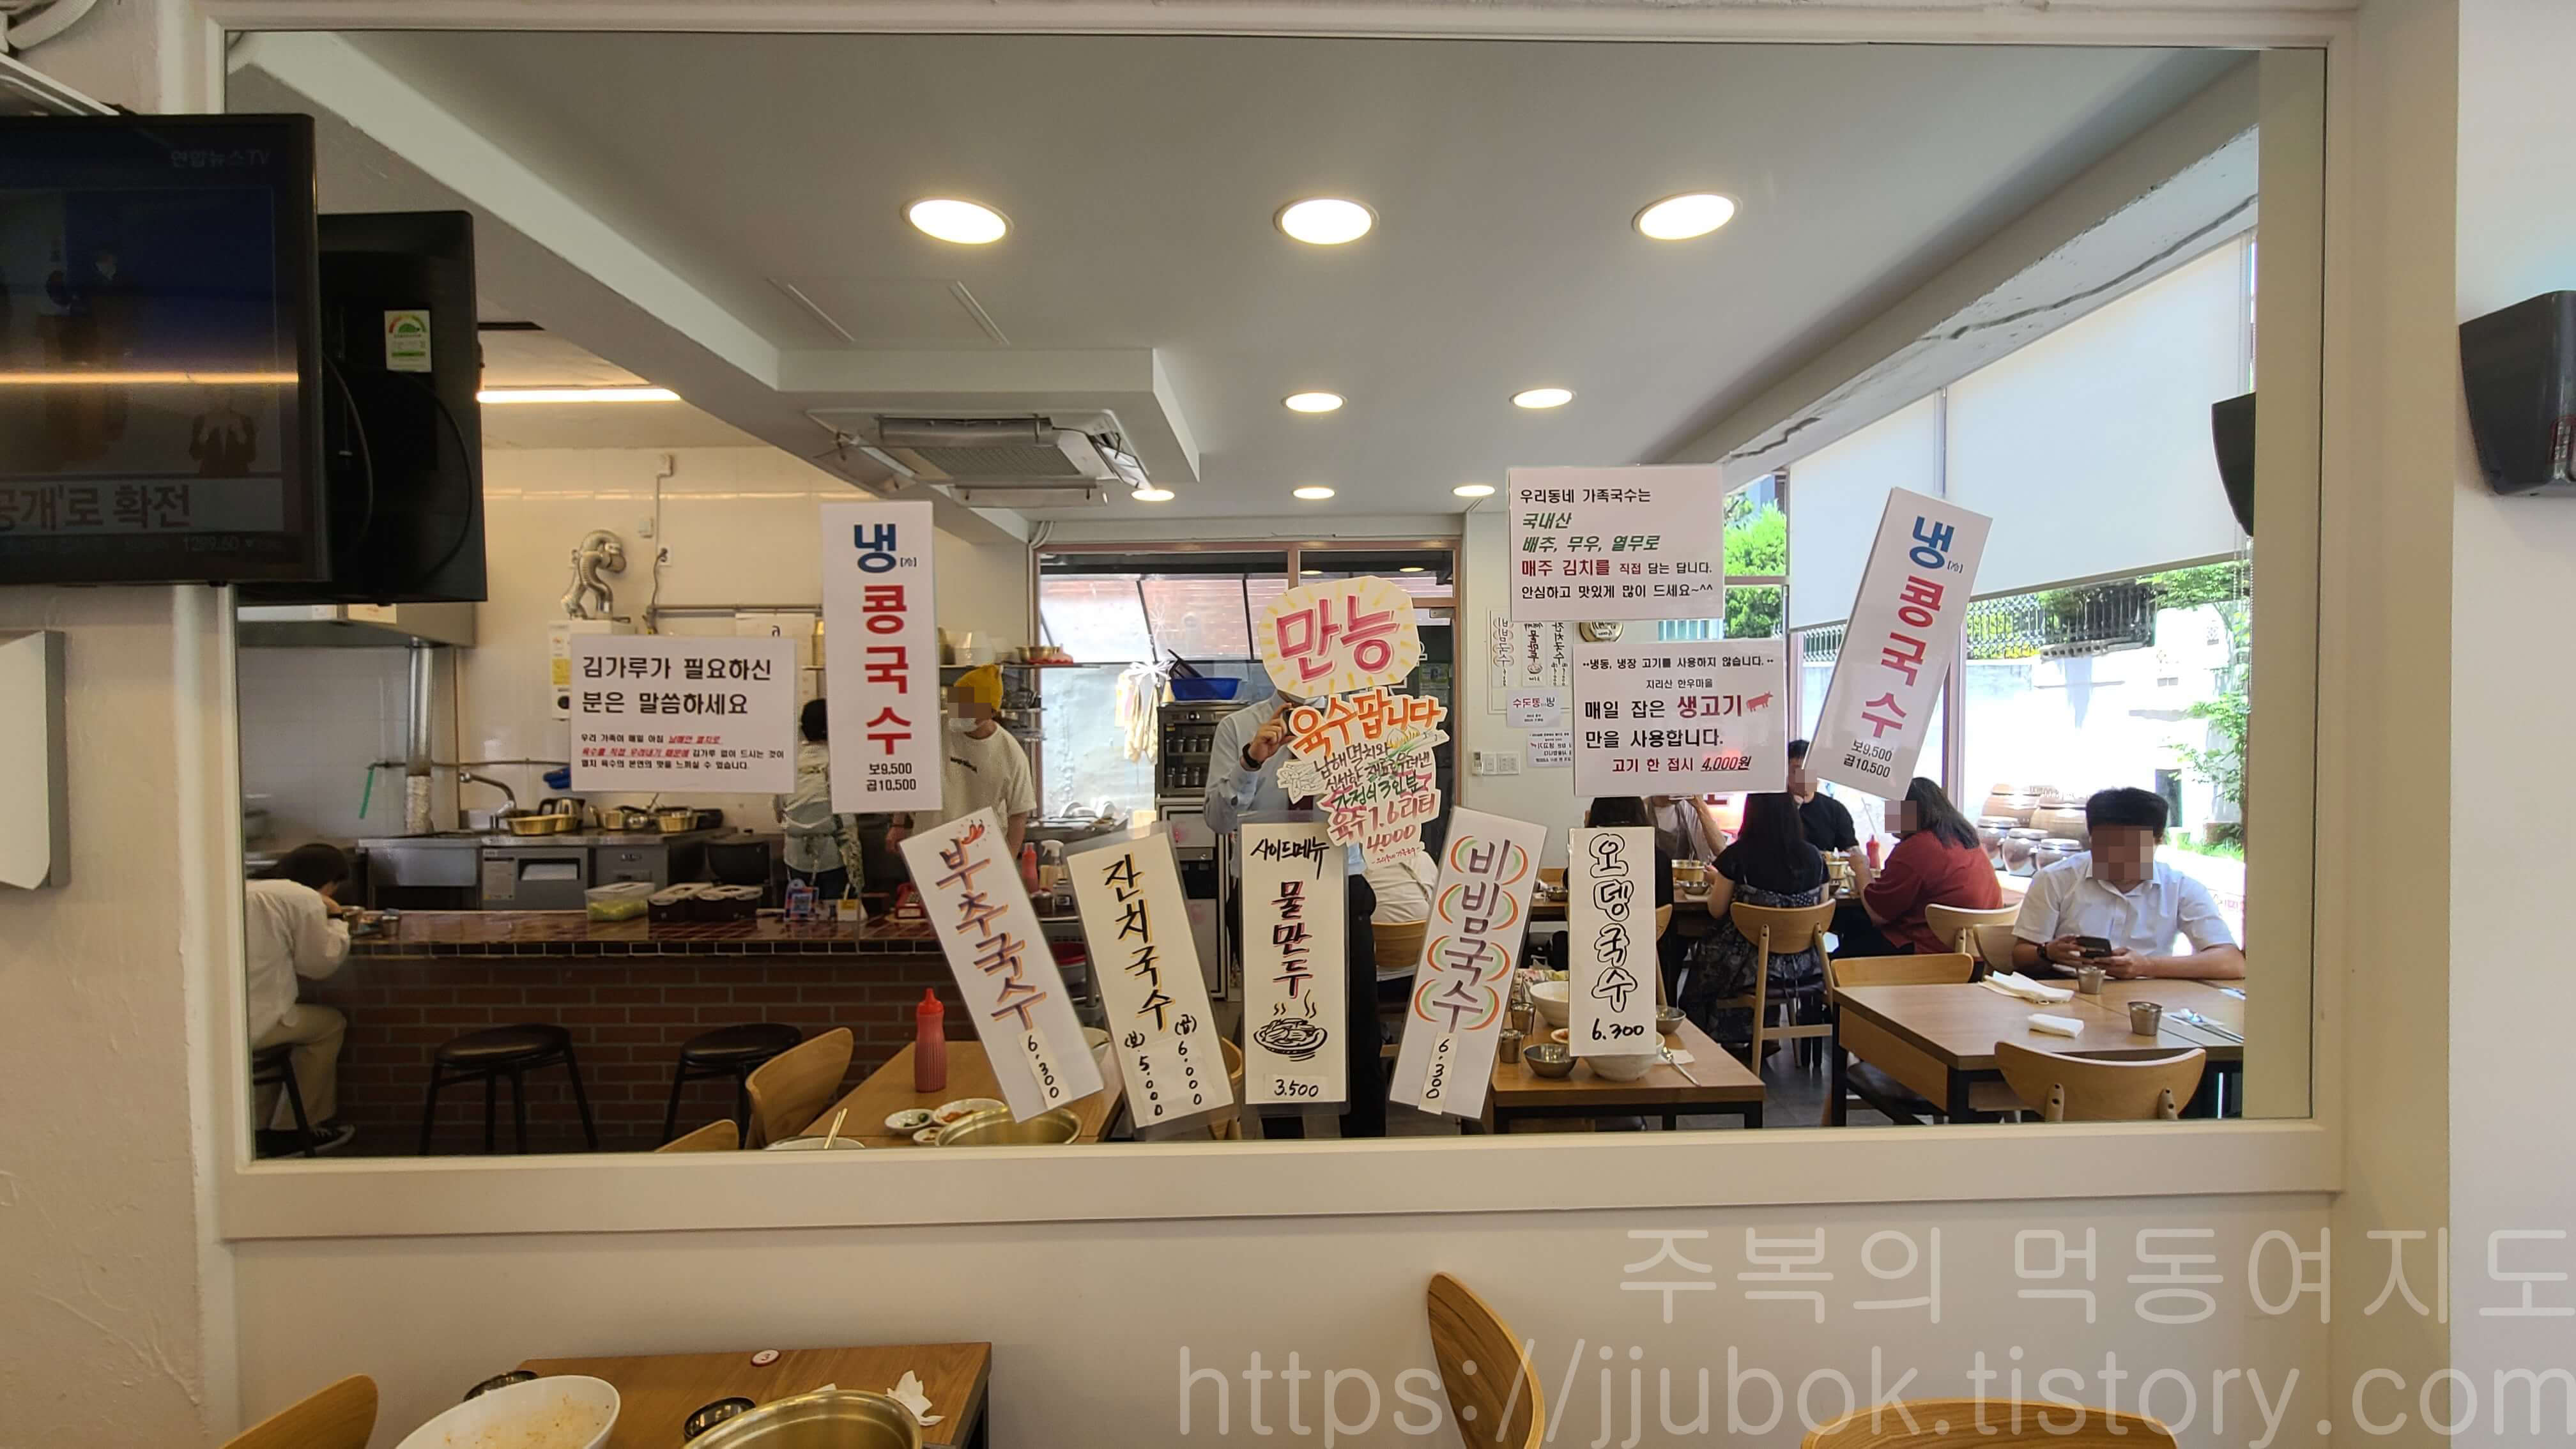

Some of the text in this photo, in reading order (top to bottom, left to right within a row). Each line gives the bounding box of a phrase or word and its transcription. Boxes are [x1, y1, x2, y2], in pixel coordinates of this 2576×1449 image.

[113, 484, 191, 530] 확전
[1520, 489, 1651, 503] 우리동네 가족국수는
[1522, 512, 1572, 529] 국내산
[1522, 535, 1660, 553] 배추, 무우, 열무로
[1522, 560, 1553, 576] 매주
[1562, 560, 1611, 576] 김치를
[1620, 563, 1641, 574] 직접
[1648, 563, 1669, 574] 담는
[1521, 585, 1571, 599] 안심하고
[1579, 585, 1615, 599] 맛있게
[1623, 585, 1646, 599] 많이
[1276, 595, 1400, 683] 만능
[582, 656, 771, 681] 김가루가 필요하신
[1617, 659, 1636, 669] 냉장
[1677, 657, 1716, 668] 사용하지
[1722, 656, 1764, 667] 않습니다.
[1646, 678, 1713, 689] 지리산 한우마을
[582, 692, 747, 715] 분은 말씀하세요
[1584, 694, 1742, 720] 매일 잡은 생고기
[581, 733, 596, 742] 우리
[601, 734, 624, 742] 가족이
[648, 735, 663, 743] 아침
[1586, 728, 1723, 749] 만을 사용합니다.
[693, 749, 716, 758] 김가루
[721, 749, 736, 758] 없이
[740, 749, 764, 758] 드시는
[769, 750, 785, 758] 것이
[1612, 756, 1752, 772] 고기 한 접시 4,000원
[1250, 836, 1330, 880] 사이드메뉴
[935, 836, 1048, 1031] 부추국수
[1589, 833, 1637, 1013] 오뎅국수
[1103, 854, 1175, 1032] 잔치국수
[1271, 880, 1314, 999] 물만두
[1432, 839, 1511, 1033] 비빔국수
